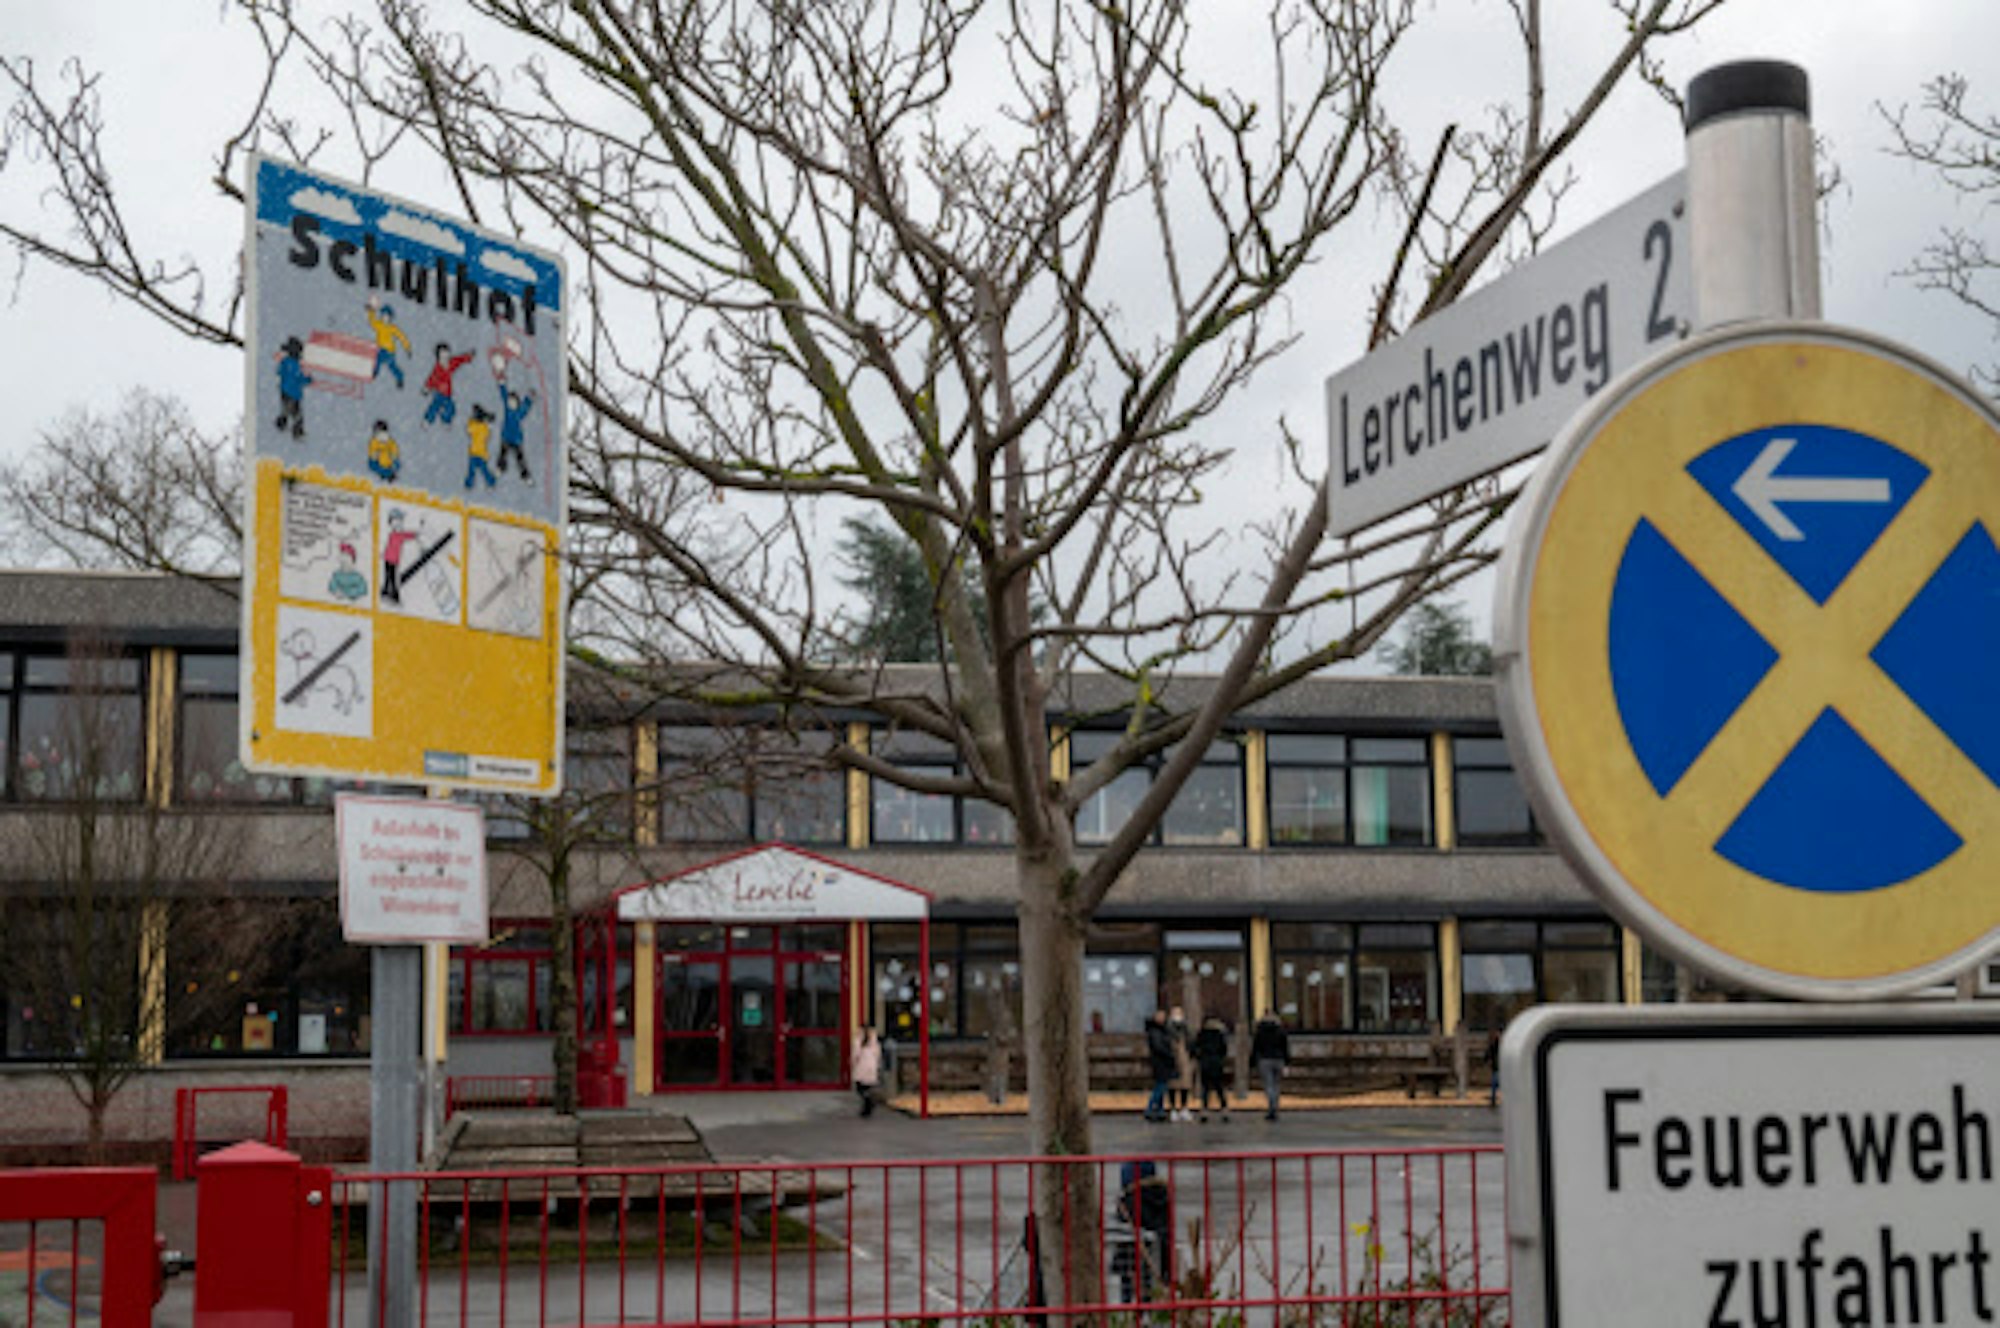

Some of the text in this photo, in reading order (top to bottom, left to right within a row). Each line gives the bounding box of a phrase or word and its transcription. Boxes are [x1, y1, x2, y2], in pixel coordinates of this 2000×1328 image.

[289, 214, 535, 336] Schulhof
[1343, 283, 1610, 487] Lerchenweg
[1603, 1083, 1992, 1192] Feuerweh
[1705, 1226, 1994, 1328] zufahrt
